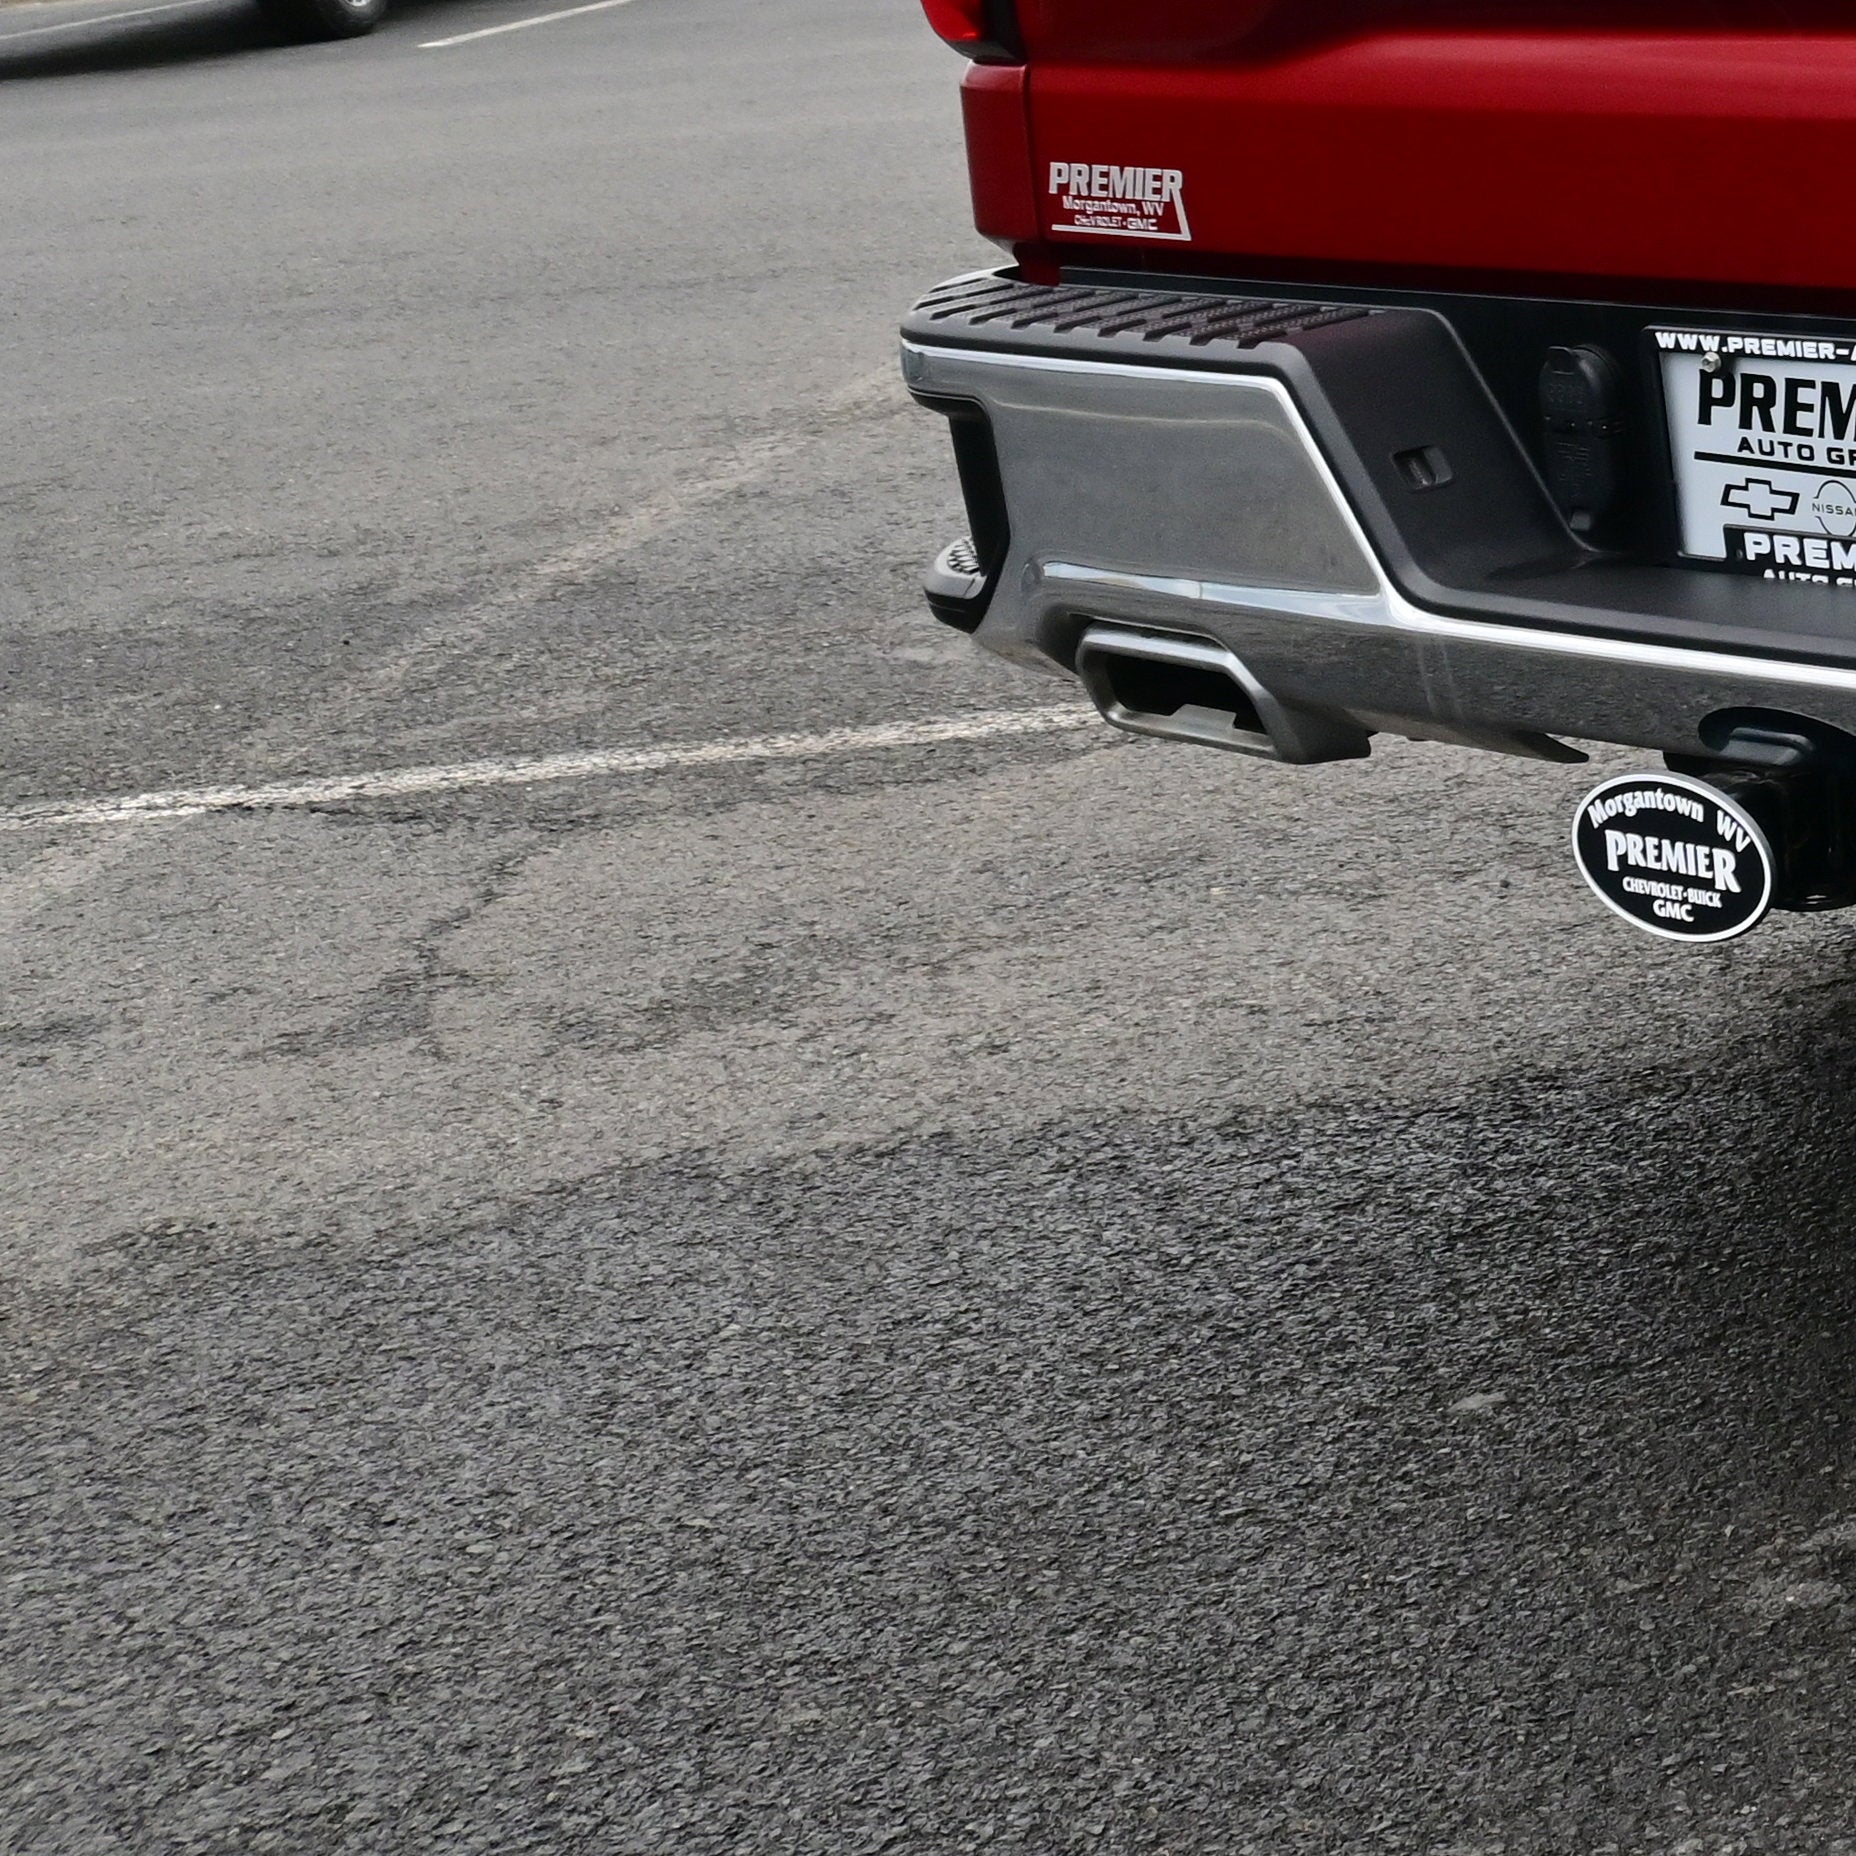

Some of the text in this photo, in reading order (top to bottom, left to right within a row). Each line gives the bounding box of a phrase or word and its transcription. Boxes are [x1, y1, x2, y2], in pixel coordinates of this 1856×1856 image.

[1048, 161, 1184, 203] PREMIER
[1062, 195, 1164, 217] Morgantown, WV
[1737, 436, 1815, 462] AUTO
[1587, 787, 1752, 853] Morgantown WV
[1604, 829, 1742, 893] PREMIER
[1653, 900, 1695, 923] GMC
